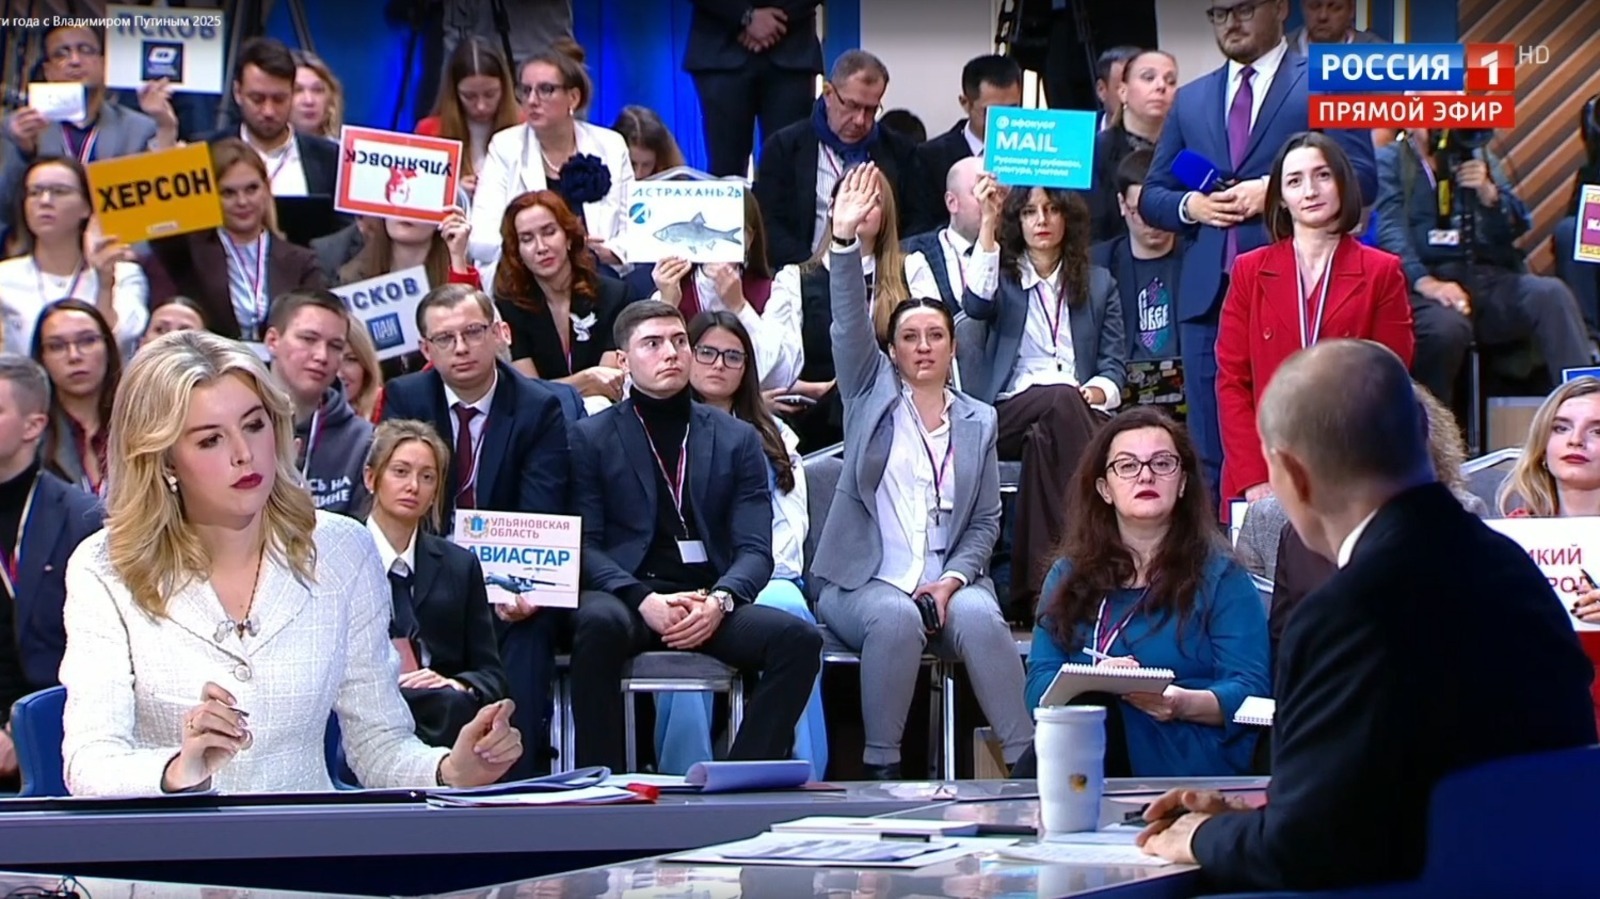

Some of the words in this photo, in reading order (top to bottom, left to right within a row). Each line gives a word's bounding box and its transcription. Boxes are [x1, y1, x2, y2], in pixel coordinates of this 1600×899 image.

[117, 13, 216, 39] ПСКОВ
[996, 130, 1058, 153] MAIL
[344, 149, 452, 177] УЛЬЯНОВСК
[98, 168, 211, 213] ХЕРСОН
[331, 475, 351, 491] НА
[490, 517, 570, 531] УЛЬЯНОВСКАЯ
[490, 527, 540, 539] ОБЛАСТЬ
